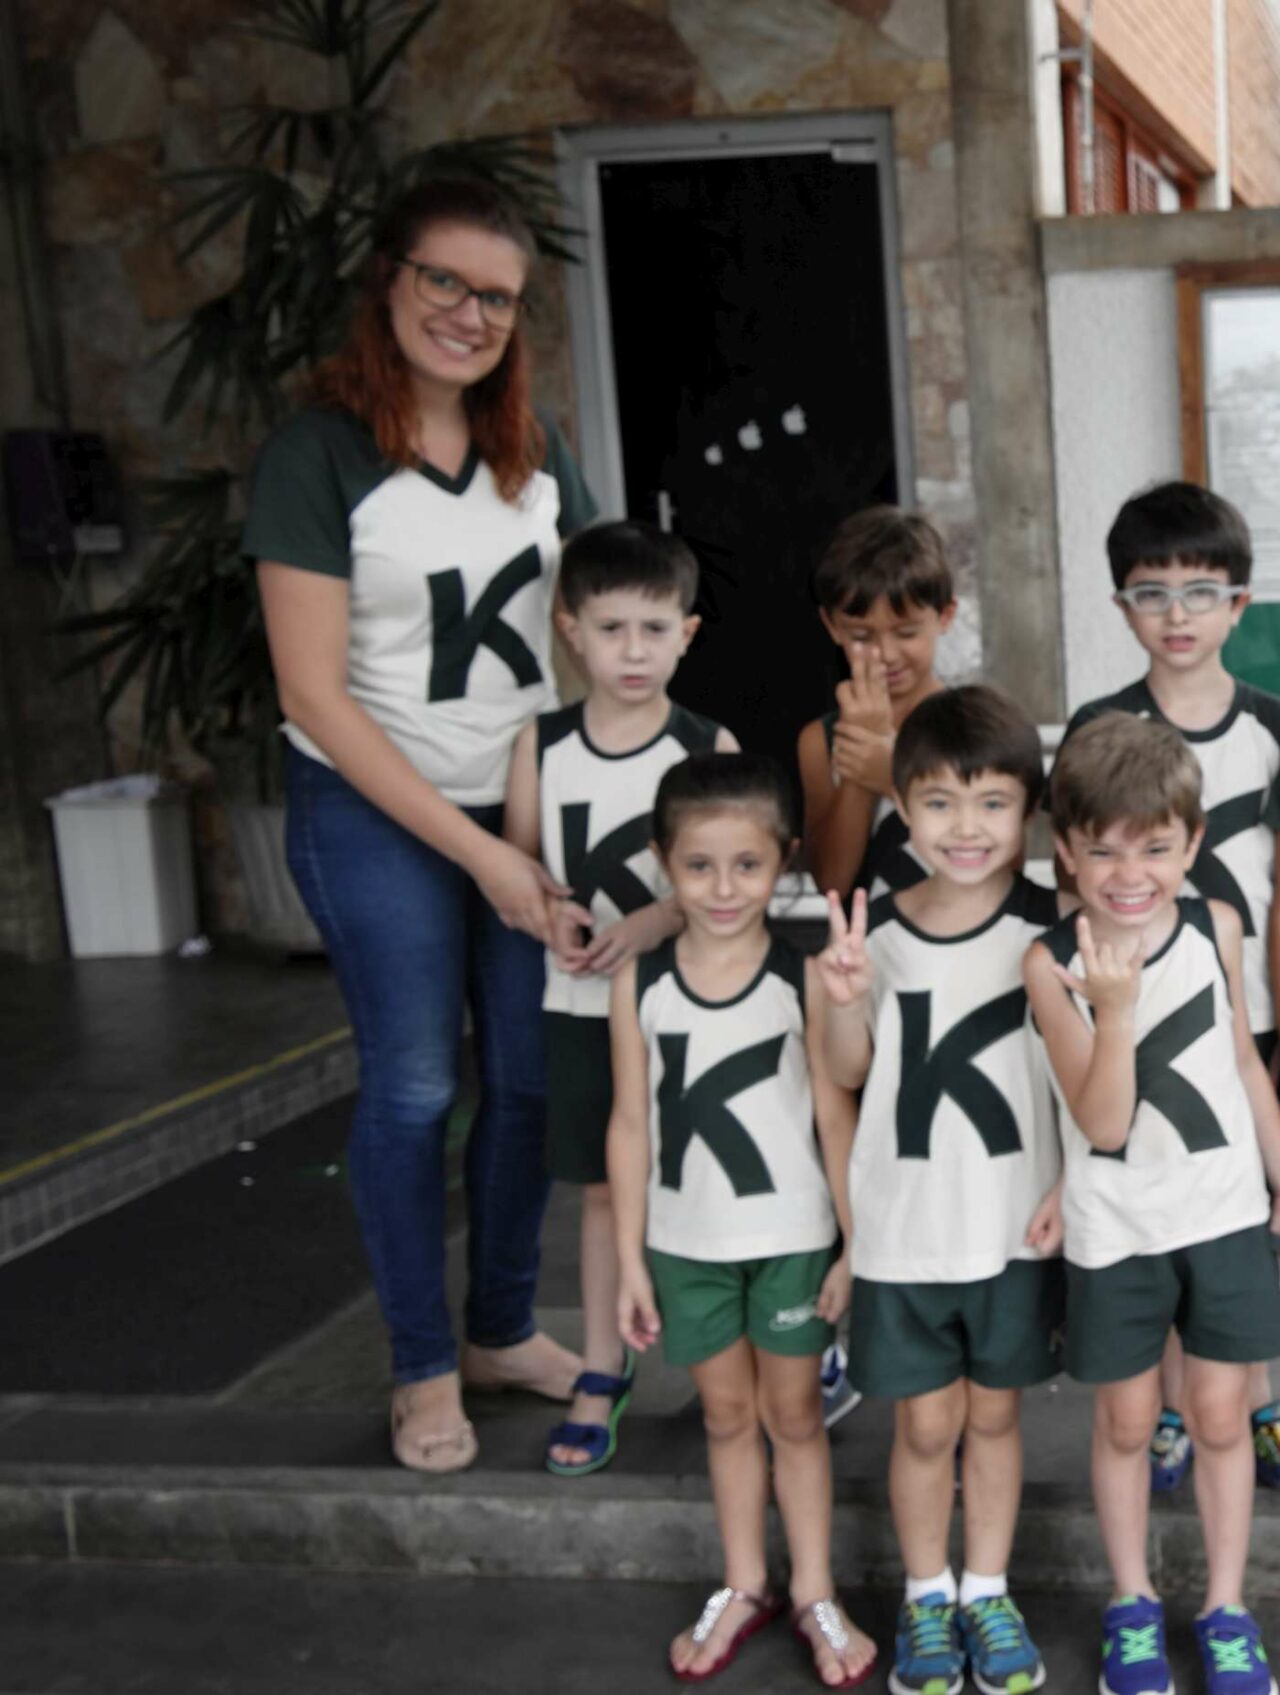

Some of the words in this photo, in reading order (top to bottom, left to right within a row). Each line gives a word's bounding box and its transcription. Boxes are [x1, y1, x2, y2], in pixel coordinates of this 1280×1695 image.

[426, 543, 544, 704] K
[561, 801, 658, 916] K
[657, 1032, 788, 1198] K
[896, 986, 1028, 1160] K
[1089, 981, 1230, 1162] K
